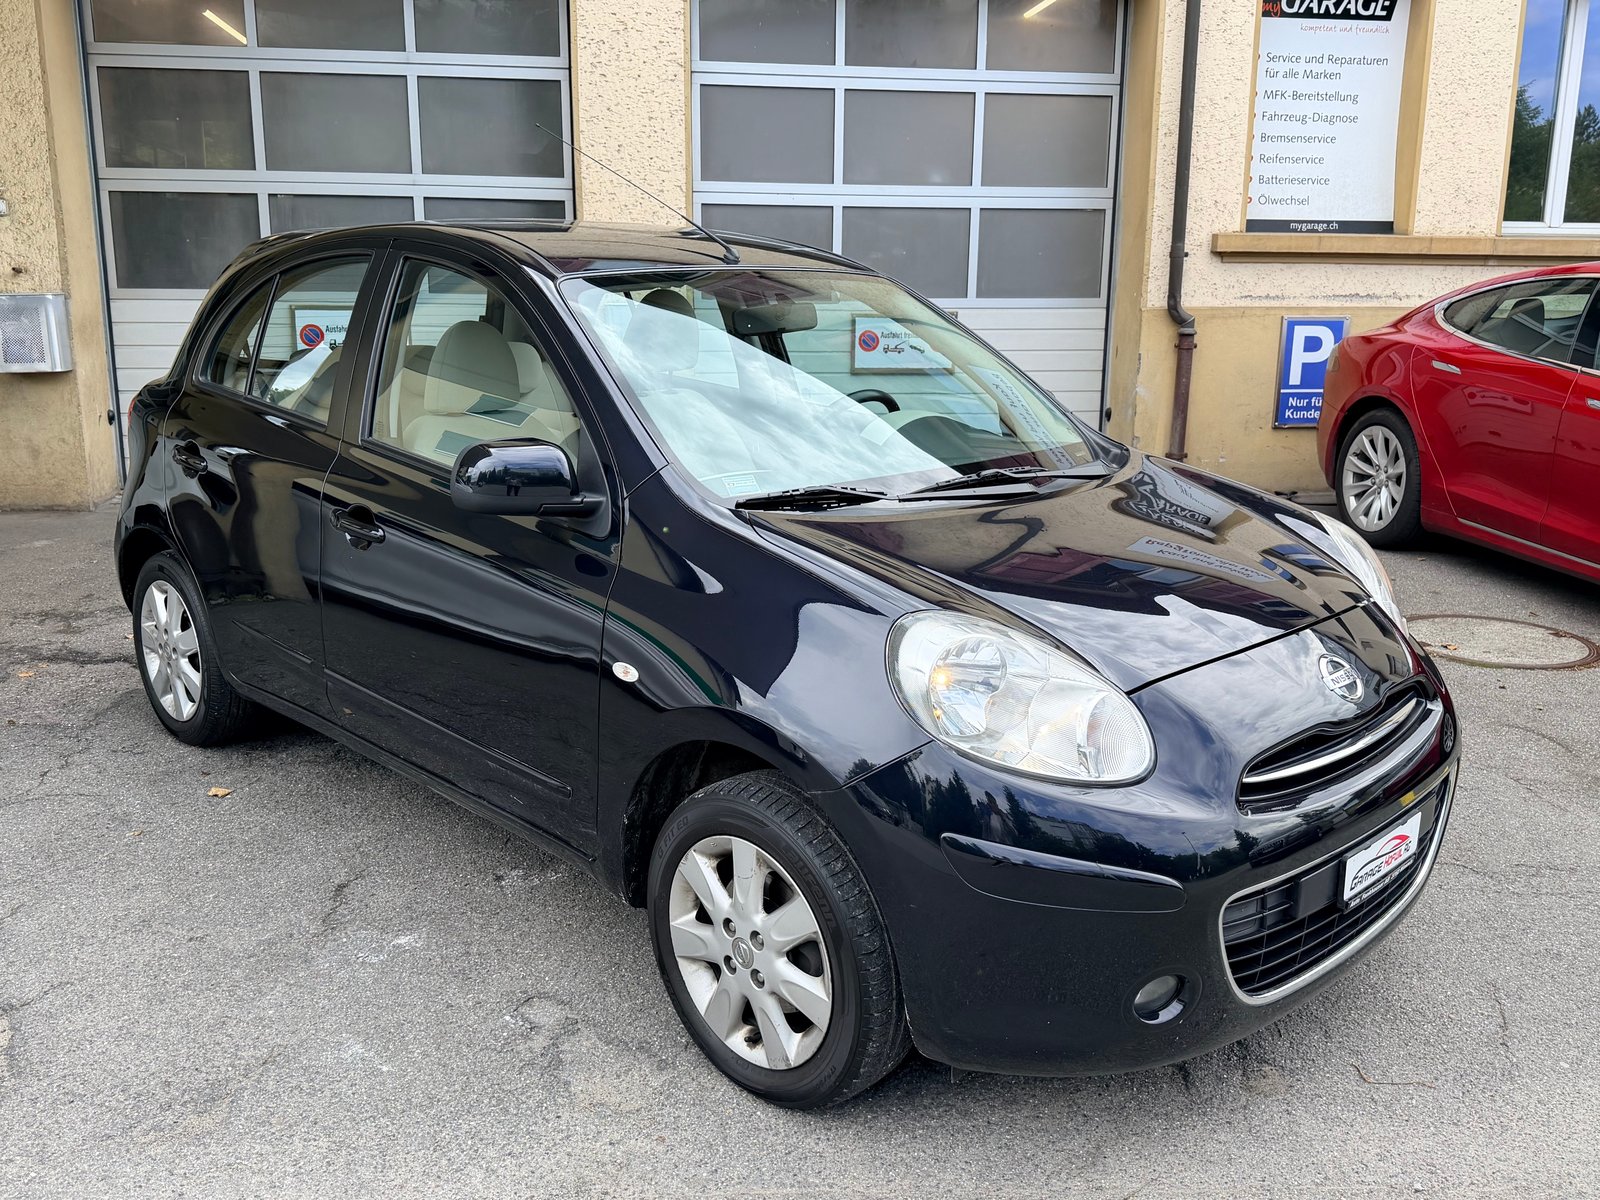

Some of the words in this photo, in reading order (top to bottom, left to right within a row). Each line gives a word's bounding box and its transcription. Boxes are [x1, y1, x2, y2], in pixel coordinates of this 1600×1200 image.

[1300, 23, 1337, 34] kompetent
[1339, 24, 1353, 33] und
[1355, 24, 1390, 35] freundlich
[1266, 52, 1301, 64] Service
[1304, 53, 1324, 64] und
[1327, 54, 1389, 68] Reparaturen
[1265, 68, 1279, 79] für
[1282, 68, 1299, 79] alle
[1302, 69, 1341, 80] Marken
[1263, 89, 1359, 105] MFK-Bereitstellung
[1261, 111, 1359, 126] Fahrzeug-Diagnose
[1260, 132, 1337, 144] Bremsenservice
[1259, 153, 1325, 165] Reifenservice
[1258, 174, 1330, 186] Batterieservice
[1257, 193, 1310, 206] Ölwechsel
[1290, 221, 1339, 232] mygarage.ch
[1289, 325, 1335, 385] P
[1288, 396, 1309, 407] Nur
[1311, 396, 1323, 407] fü
[1285, 408, 1321, 419] Kunde
